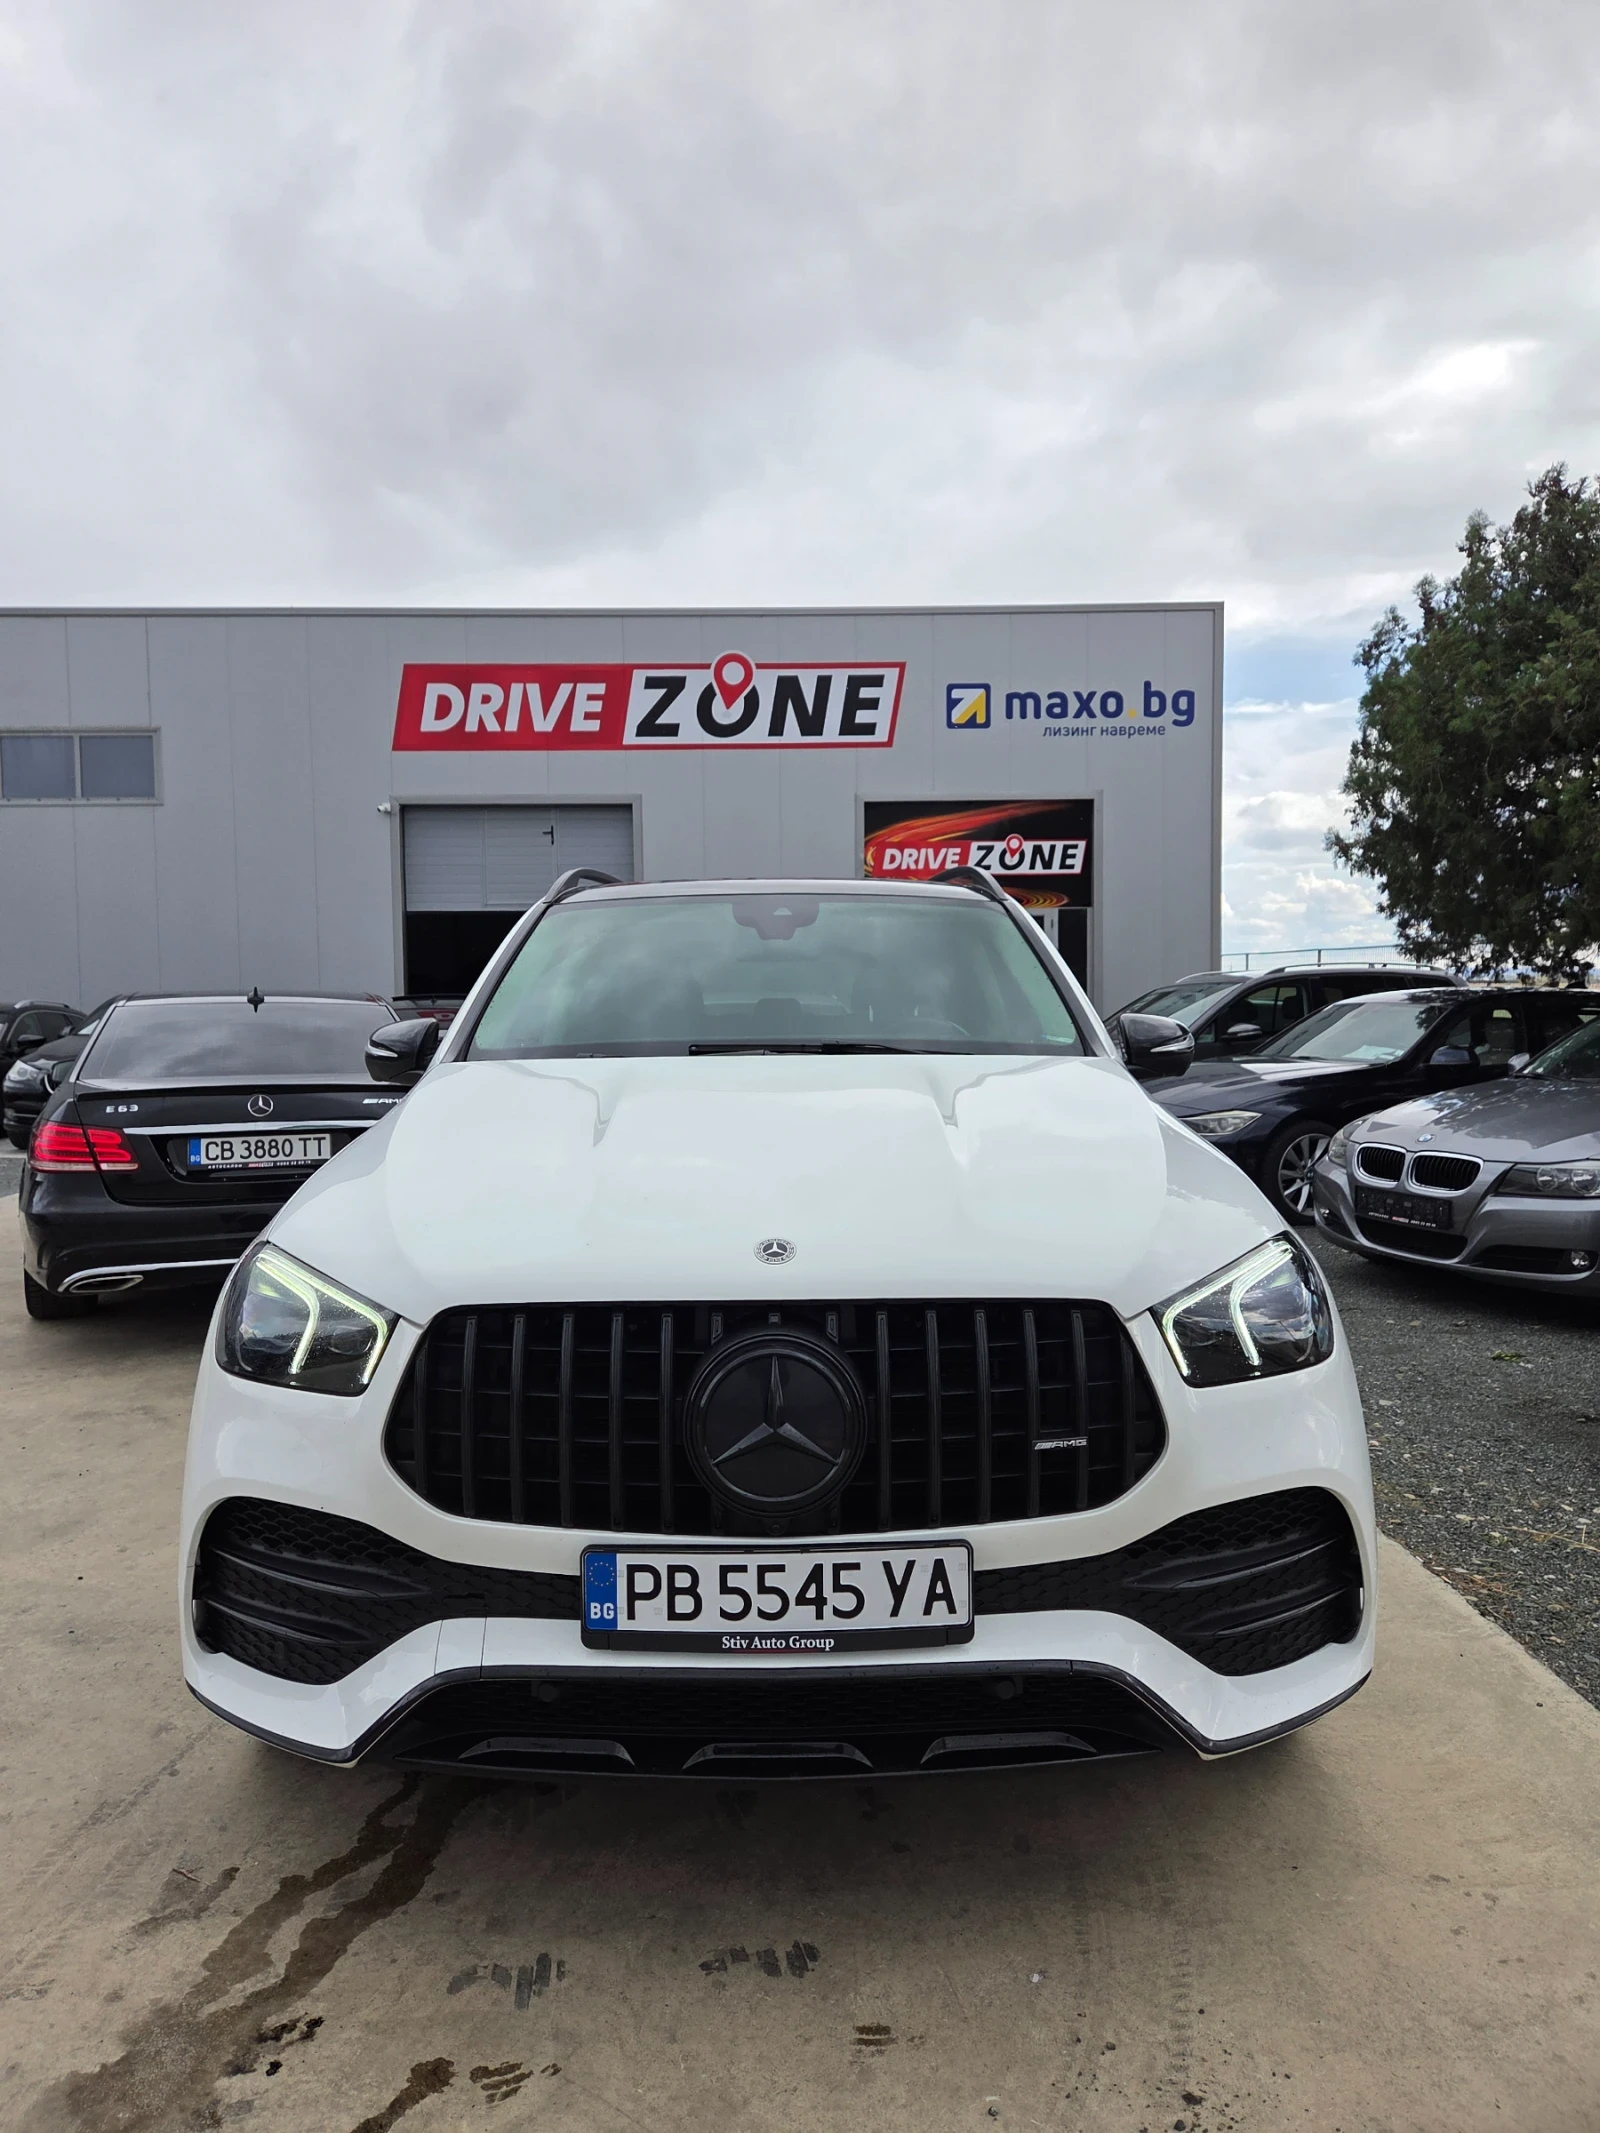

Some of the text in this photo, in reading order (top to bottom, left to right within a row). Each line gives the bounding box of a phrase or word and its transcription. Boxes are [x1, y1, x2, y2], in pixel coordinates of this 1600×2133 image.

[419, 673, 885, 738] DRIVE ZONE
[1005, 680, 1196, 727] maxo.bg
[1042, 725, 1166, 739] лизинг навреме
[882, 843, 1079, 871] DRIVE ZONE
[205, 1141, 234, 1161] CB
[240, 1138, 293, 1159] 3880
[298, 1136, 326, 1157] TT
[1051, 1439, 1087, 1448] AMG
[590, 1558, 957, 1621] BG PB 5545 YA
[722, 1635, 835, 1652] Stiv Auto Group
